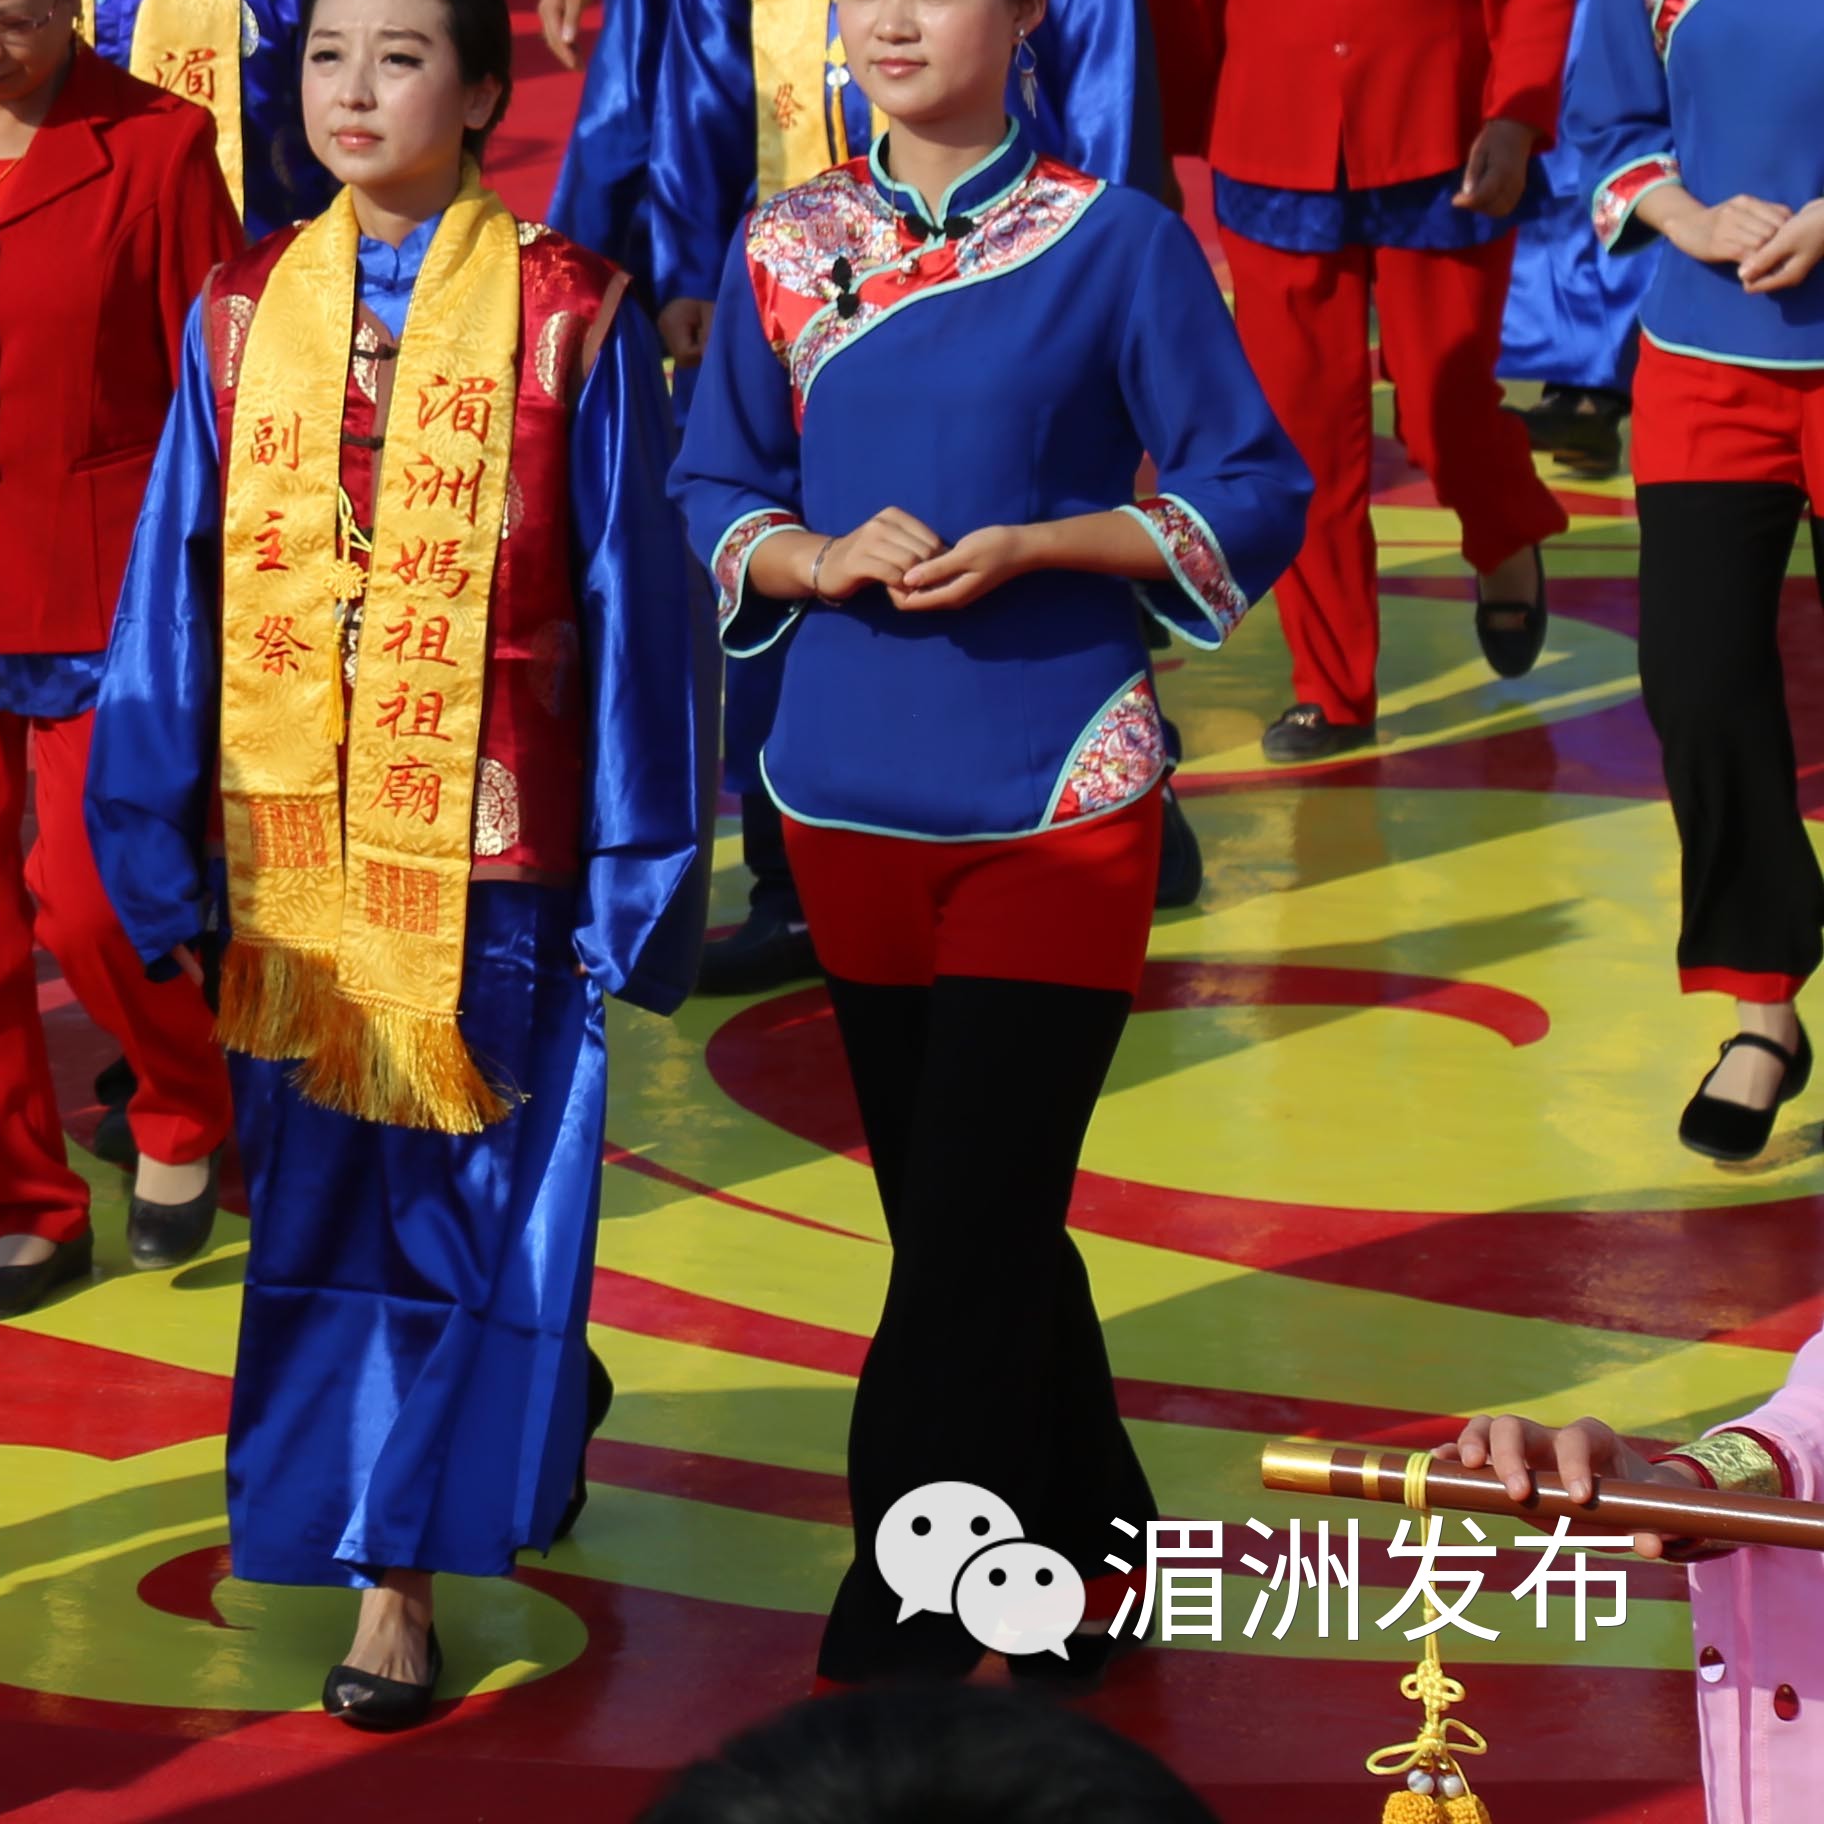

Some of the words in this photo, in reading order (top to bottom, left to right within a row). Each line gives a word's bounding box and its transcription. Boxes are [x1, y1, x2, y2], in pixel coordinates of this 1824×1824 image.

[249, 411, 315, 676] 副主祭
[367, 372, 499, 826] 湄洲媽祖祖廟
